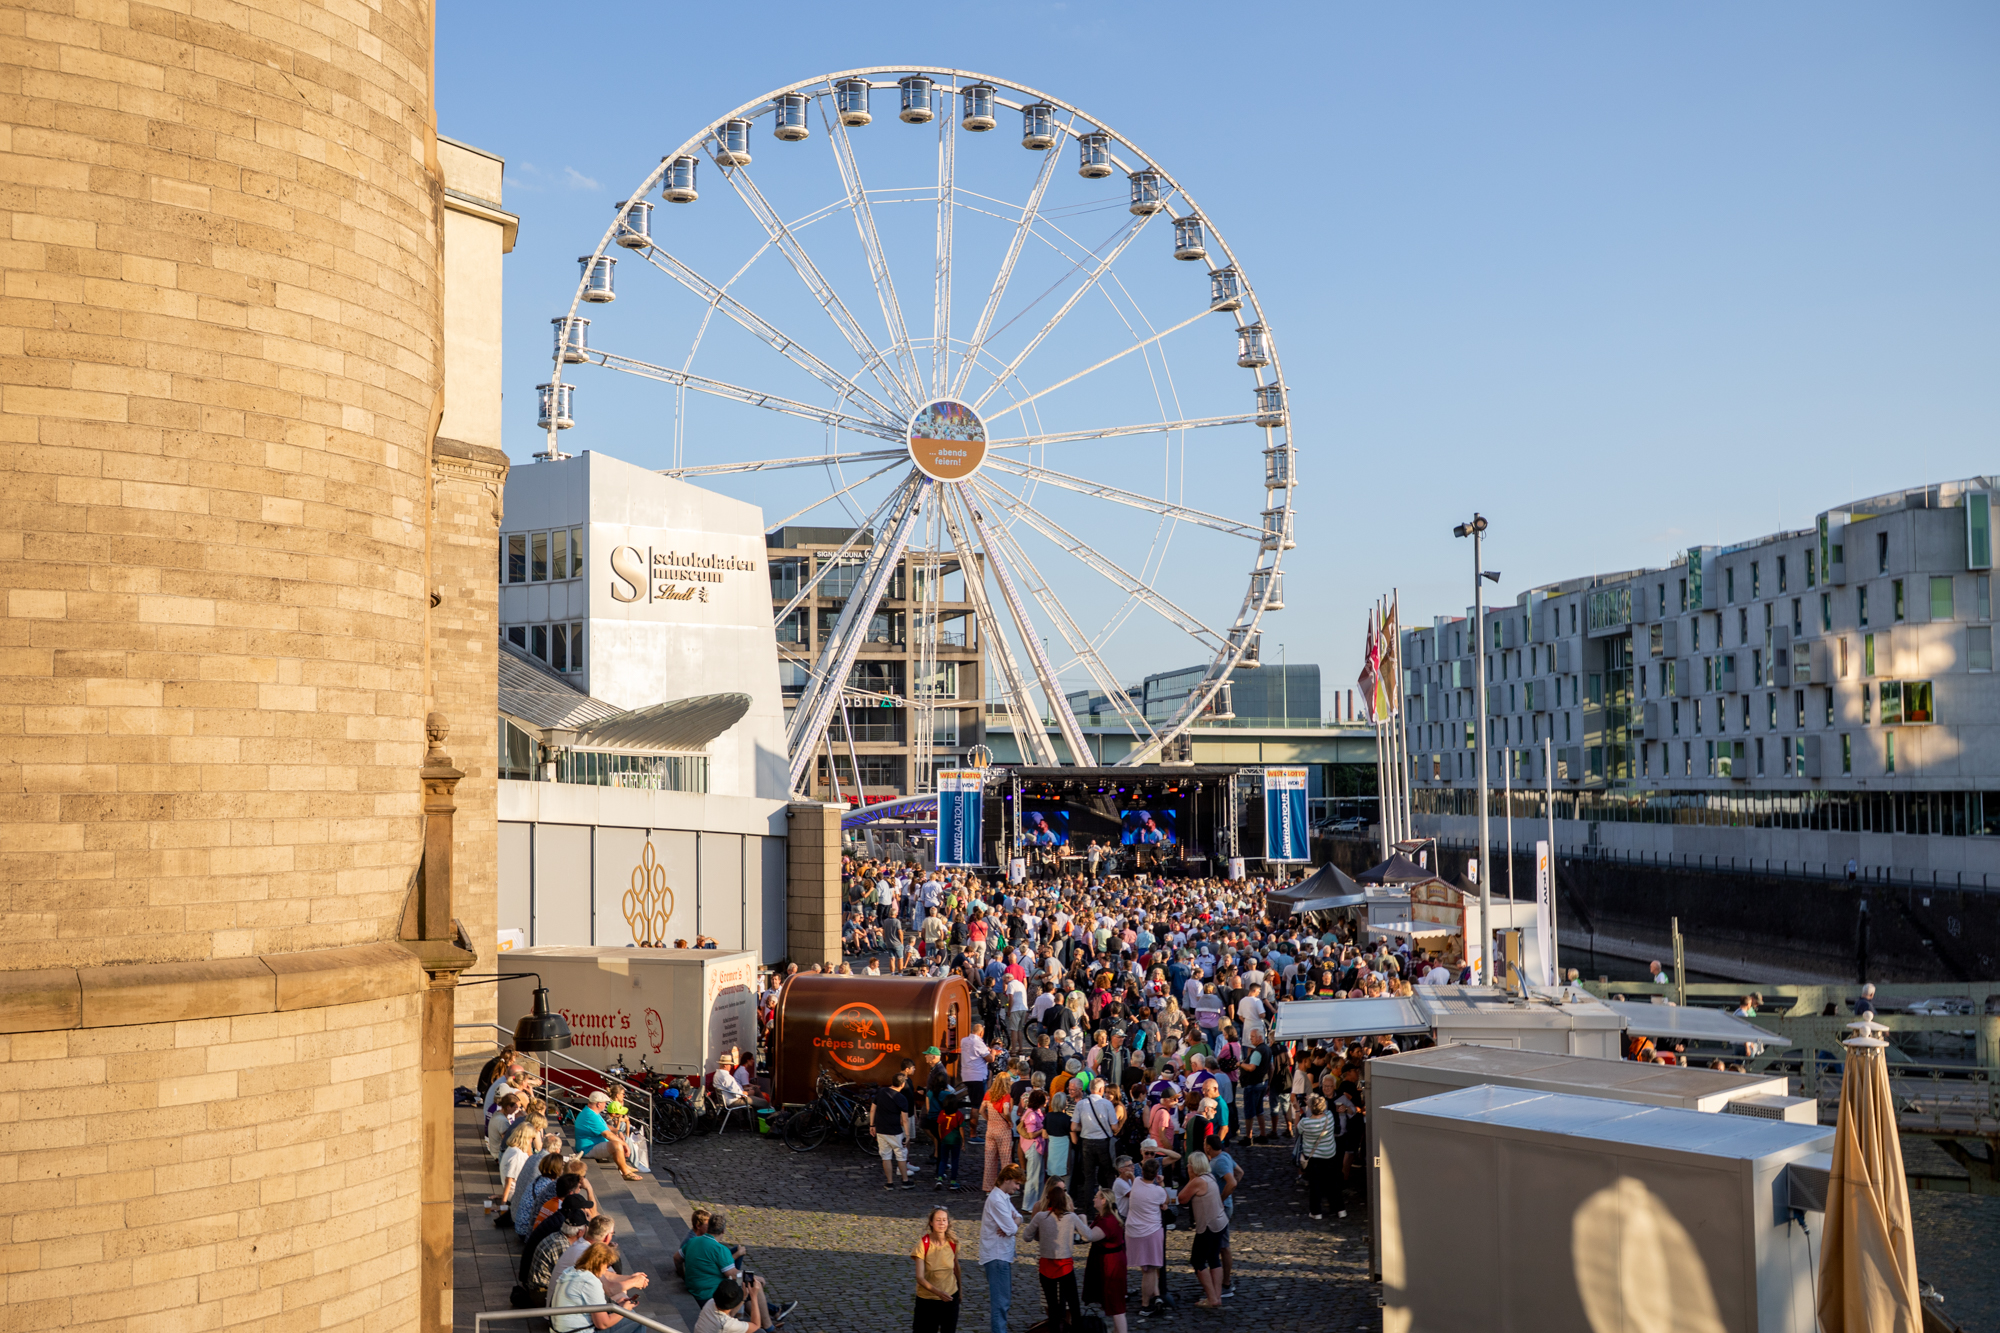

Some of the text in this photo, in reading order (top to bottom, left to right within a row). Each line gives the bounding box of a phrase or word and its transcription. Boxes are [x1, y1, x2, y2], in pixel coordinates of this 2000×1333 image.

[938, 448, 967, 457] abends
[935, 457, 962, 466] feiern!
[653, 551, 757, 571] schokoladen
[610, 544, 647, 603] S
[653, 568, 724, 583] museum
[653, 583, 697, 601] Lindt
[838, 695, 904, 708] OBILAB
[954, 795, 962, 861] NRWRADTOUR
[570, 1030, 638, 1051] atenhaus
[813, 1036, 901, 1053] Crêpes Lounge
[846, 1055, 865, 1064] Köln
[945, 1116, 952, 1130] 7
